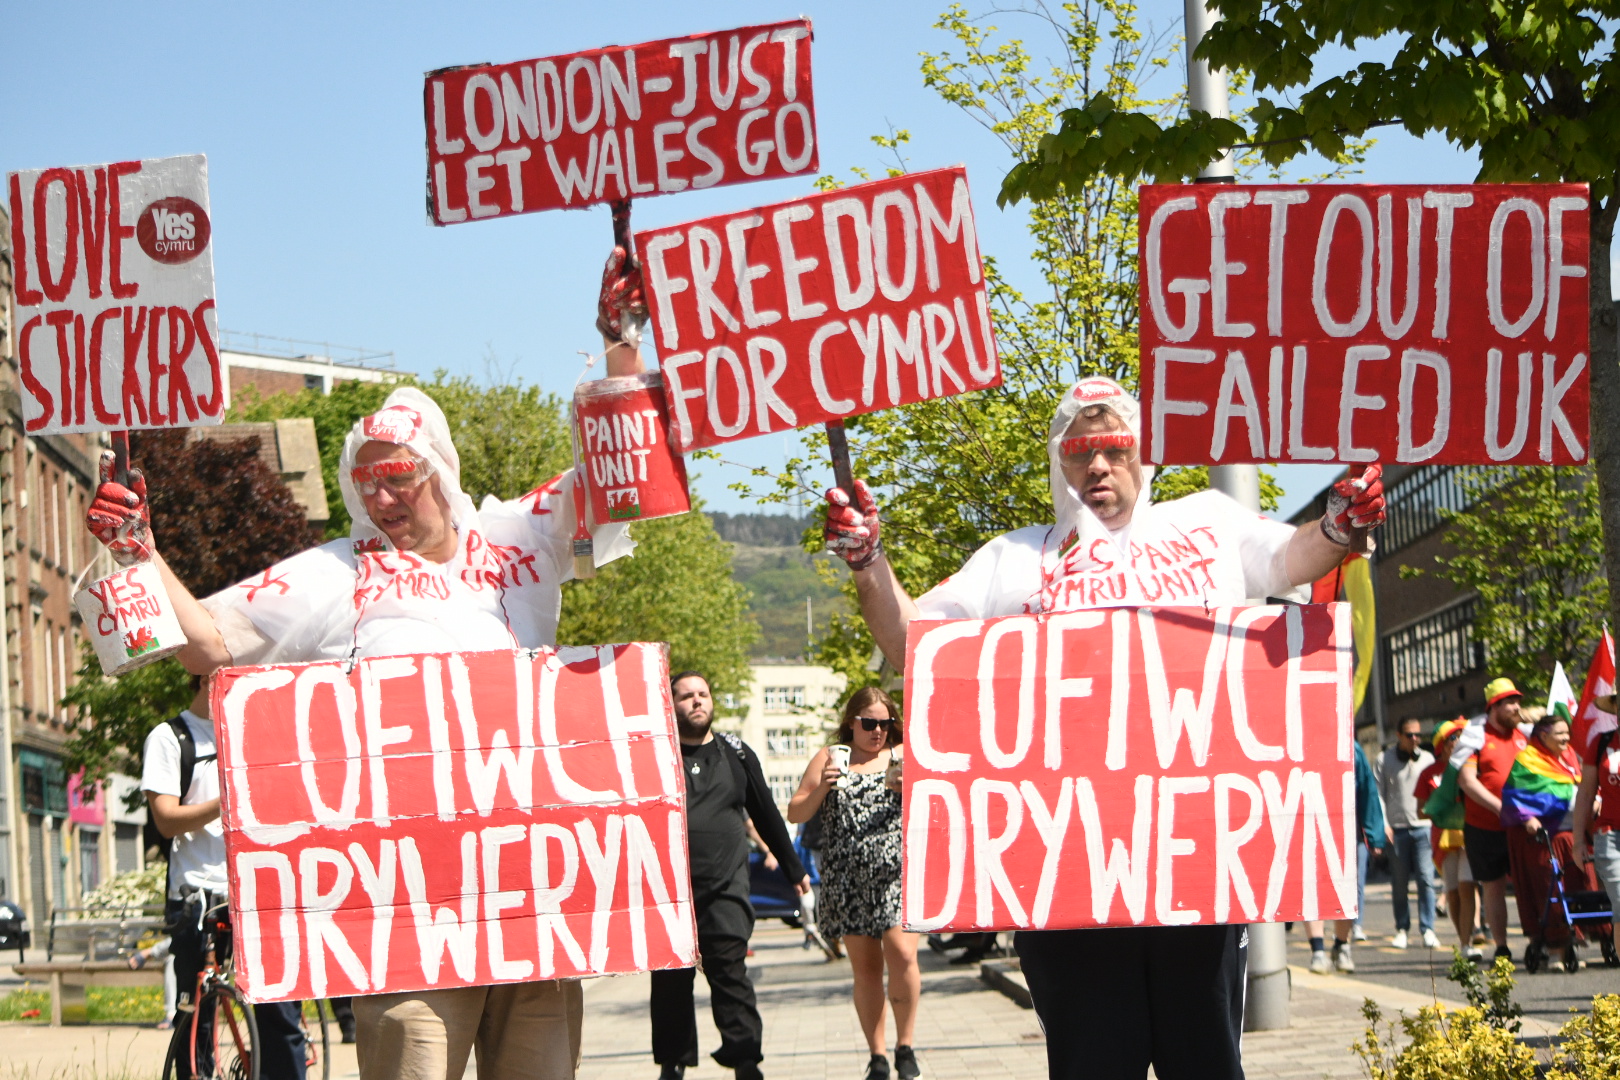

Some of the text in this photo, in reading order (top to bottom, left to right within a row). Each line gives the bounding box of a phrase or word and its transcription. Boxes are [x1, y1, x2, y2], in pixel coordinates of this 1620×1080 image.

[433, 27, 809, 155] LONDON-JUST
[434, 102, 813, 224] LET WALES GO
[10, 160, 142, 306] LOVE
[152, 208, 195, 240] Yes
[155, 240, 195, 255] cymru
[646, 177, 980, 351] FREEDOM
[1146, 190, 1588, 342] GET OUT OF
[19, 299, 223, 432] STICKERS
[662, 290, 996, 448] FOR CYMRU
[1150, 345, 1587, 465] FAILED UK
[351, 465, 372, 484] YES
[584, 410, 659, 452] PAINT
[591, 449, 651, 487] UNIT
[1061, 436, 1089, 456] YES
[88, 567, 147, 614] YES
[98, 595, 162, 636] CYMRU
[1042, 526, 1219, 584] YES PAINT
[1136, 558, 1216, 602] UNIT
[223, 644, 682, 845] COFIWCH
[909, 605, 1351, 773] COFIWCH
[236, 809, 698, 999] DRYWERYN
[907, 767, 1358, 929] DRYWERYN
